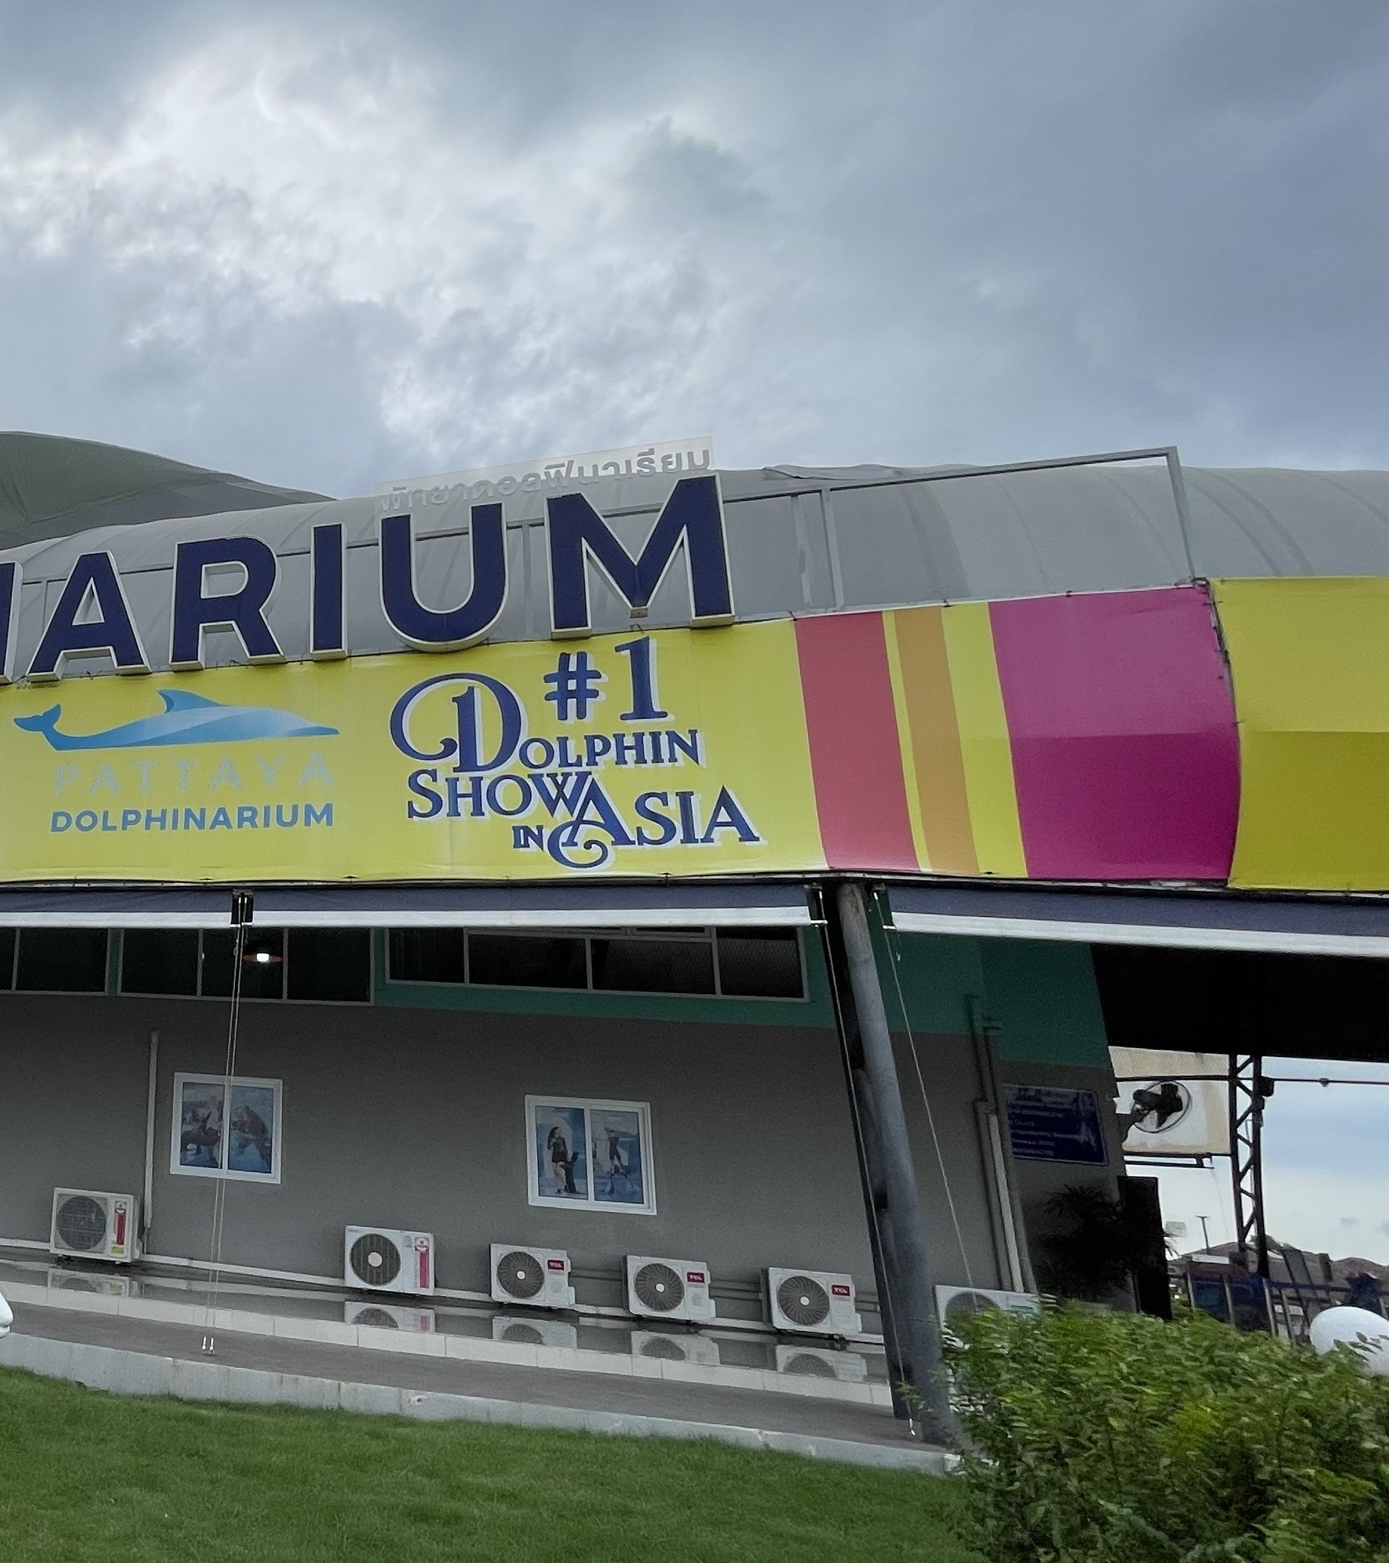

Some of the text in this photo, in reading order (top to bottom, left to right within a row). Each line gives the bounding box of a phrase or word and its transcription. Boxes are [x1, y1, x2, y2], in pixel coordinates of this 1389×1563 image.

[543, 635, 671, 722] #1
[389, 672, 701, 773] DOLPHIN
[53, 752, 334, 797] PATTAYA
[407, 768, 593, 819] SHOW
[50, 802, 334, 832] DOLPHINARIUM
[512, 784, 761, 869] IN ASIA
